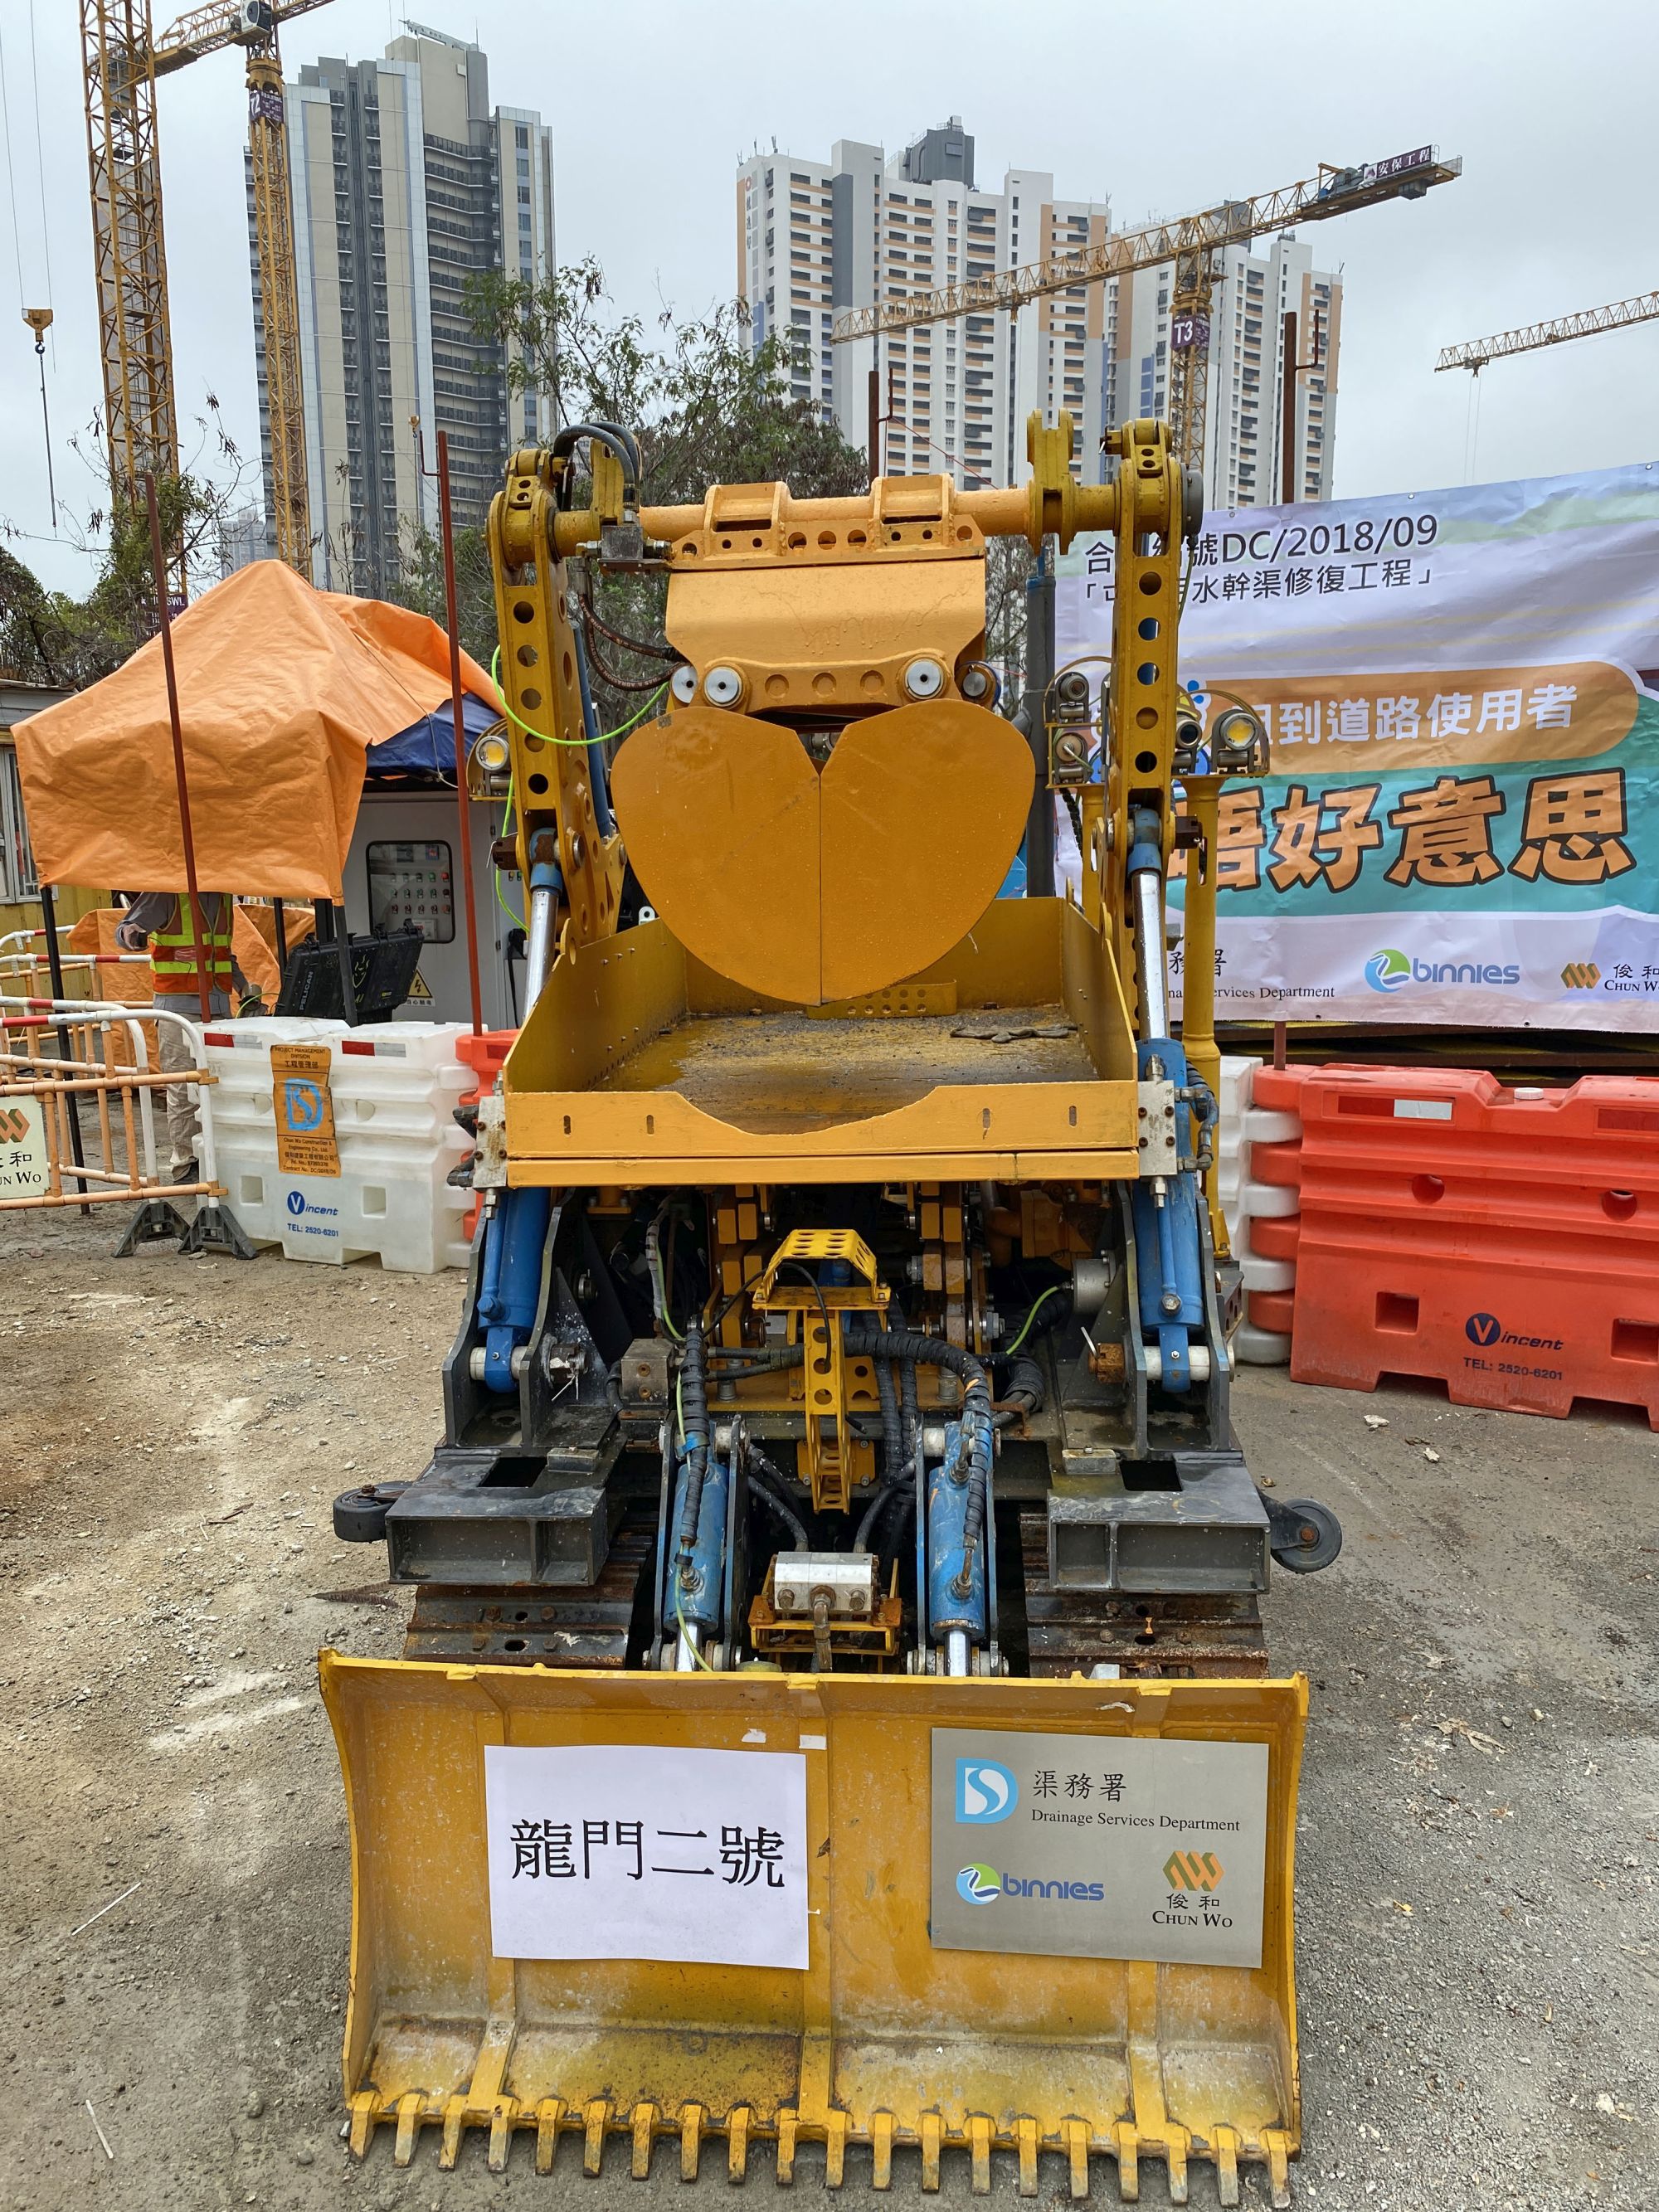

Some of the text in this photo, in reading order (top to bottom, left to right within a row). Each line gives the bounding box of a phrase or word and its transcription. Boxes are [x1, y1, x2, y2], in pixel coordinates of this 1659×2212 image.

[1378, 148, 1431, 177] 安保工程
[1174, 320, 1194, 344] T3
[1085, 514, 1438, 576] 合號DC/2018/09
[1413, 957, 1520, 986] binnies
[299, 970, 314, 1011] PELICAN
[1259, 986, 1335, 1001] Department
[287, 1190, 339, 1216] Vincent
[287, 1223, 339, 1237] TEL: 2520-6201
[1465, 1312, 1564, 1351] Vincent
[1462, 1356, 1564, 1381] TEL: 2520-6201
[1033, 1769, 1127, 1803] 渠務署
[1031, 1808, 1240, 1832] Drainage Services Department
[509, 1818, 786, 1889] 龍門二號
[1002, 1872, 1105, 1902] binnies
[1165, 1892, 1220, 1910] 俊和
